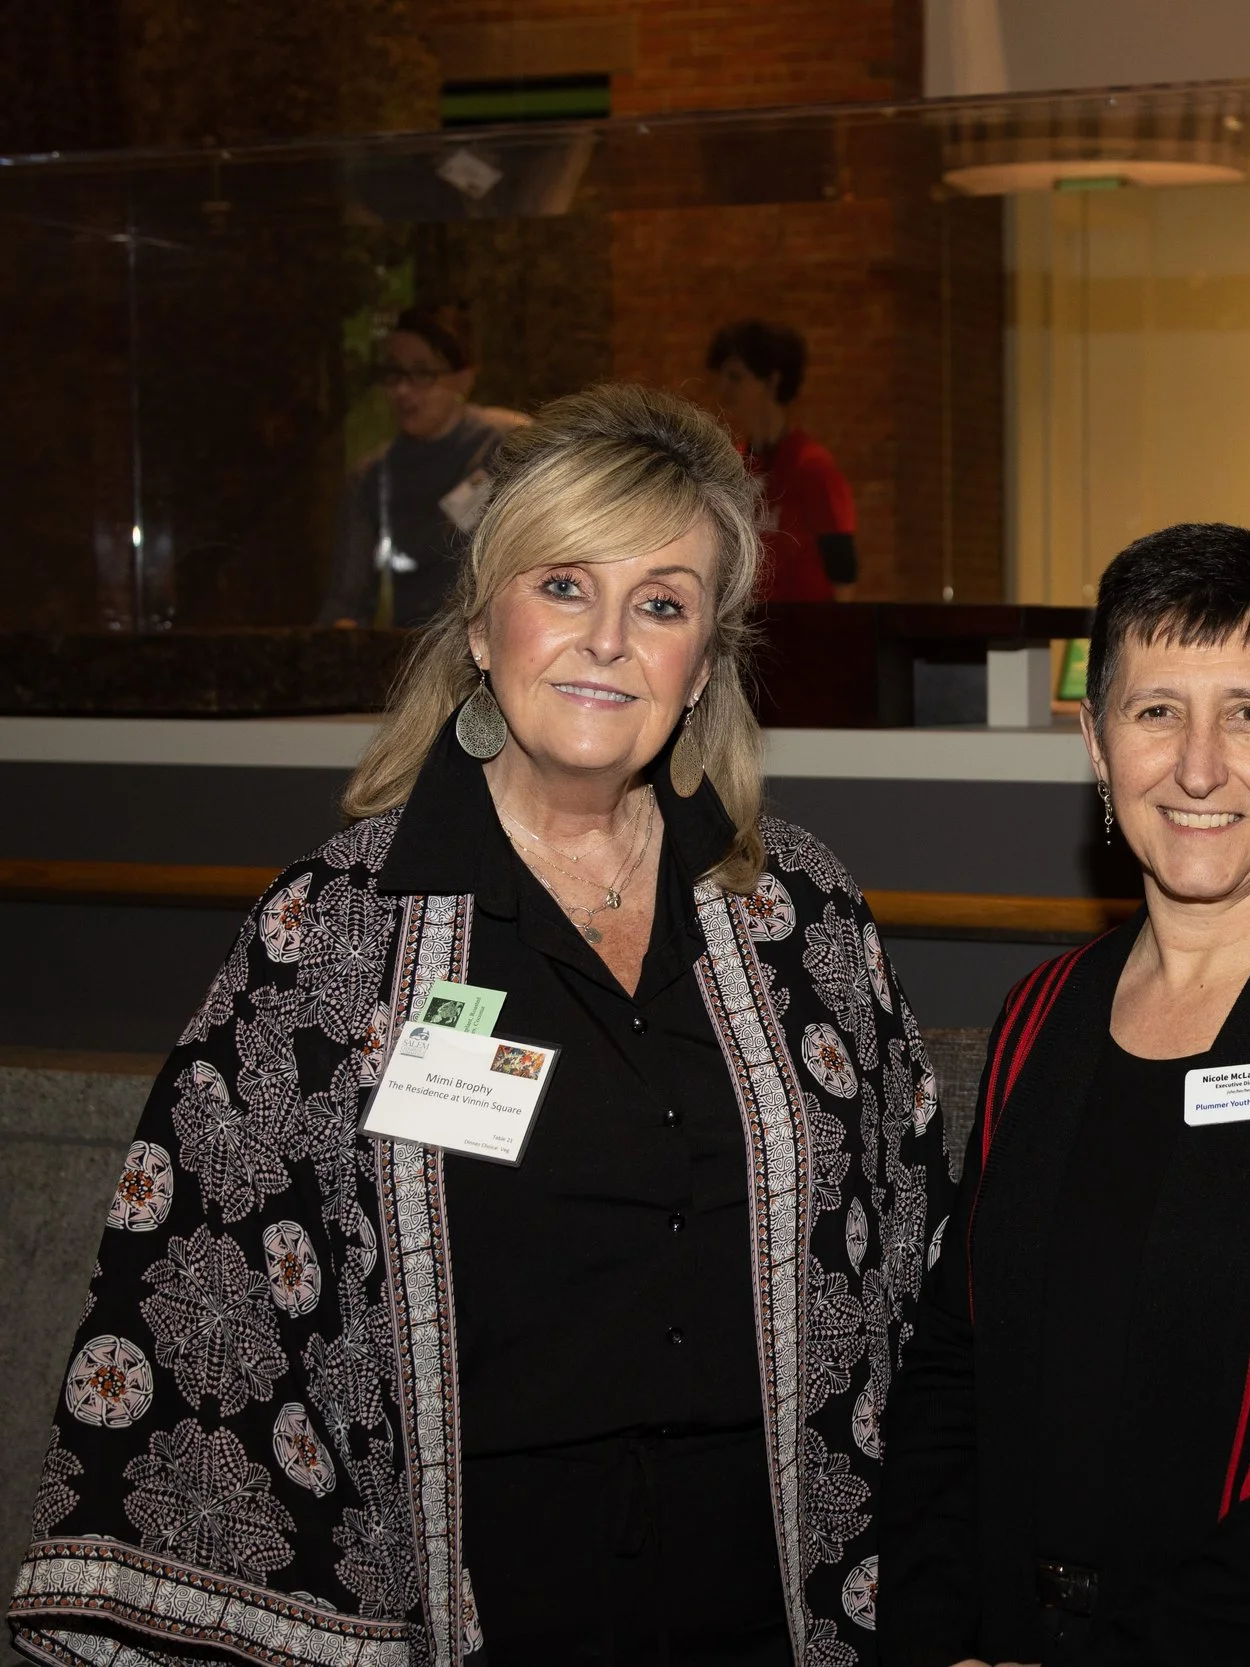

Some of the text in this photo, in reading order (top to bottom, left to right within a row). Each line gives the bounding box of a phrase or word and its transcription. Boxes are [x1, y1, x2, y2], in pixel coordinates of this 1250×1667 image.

[426, 1073, 493, 1096] Mimi Brophy
[1203, 1074, 1229, 1083] Nicole
[388, 1080, 522, 1115] The Residence at Vinnin Square
[1196, 1102, 1229, 1110] Plummer
